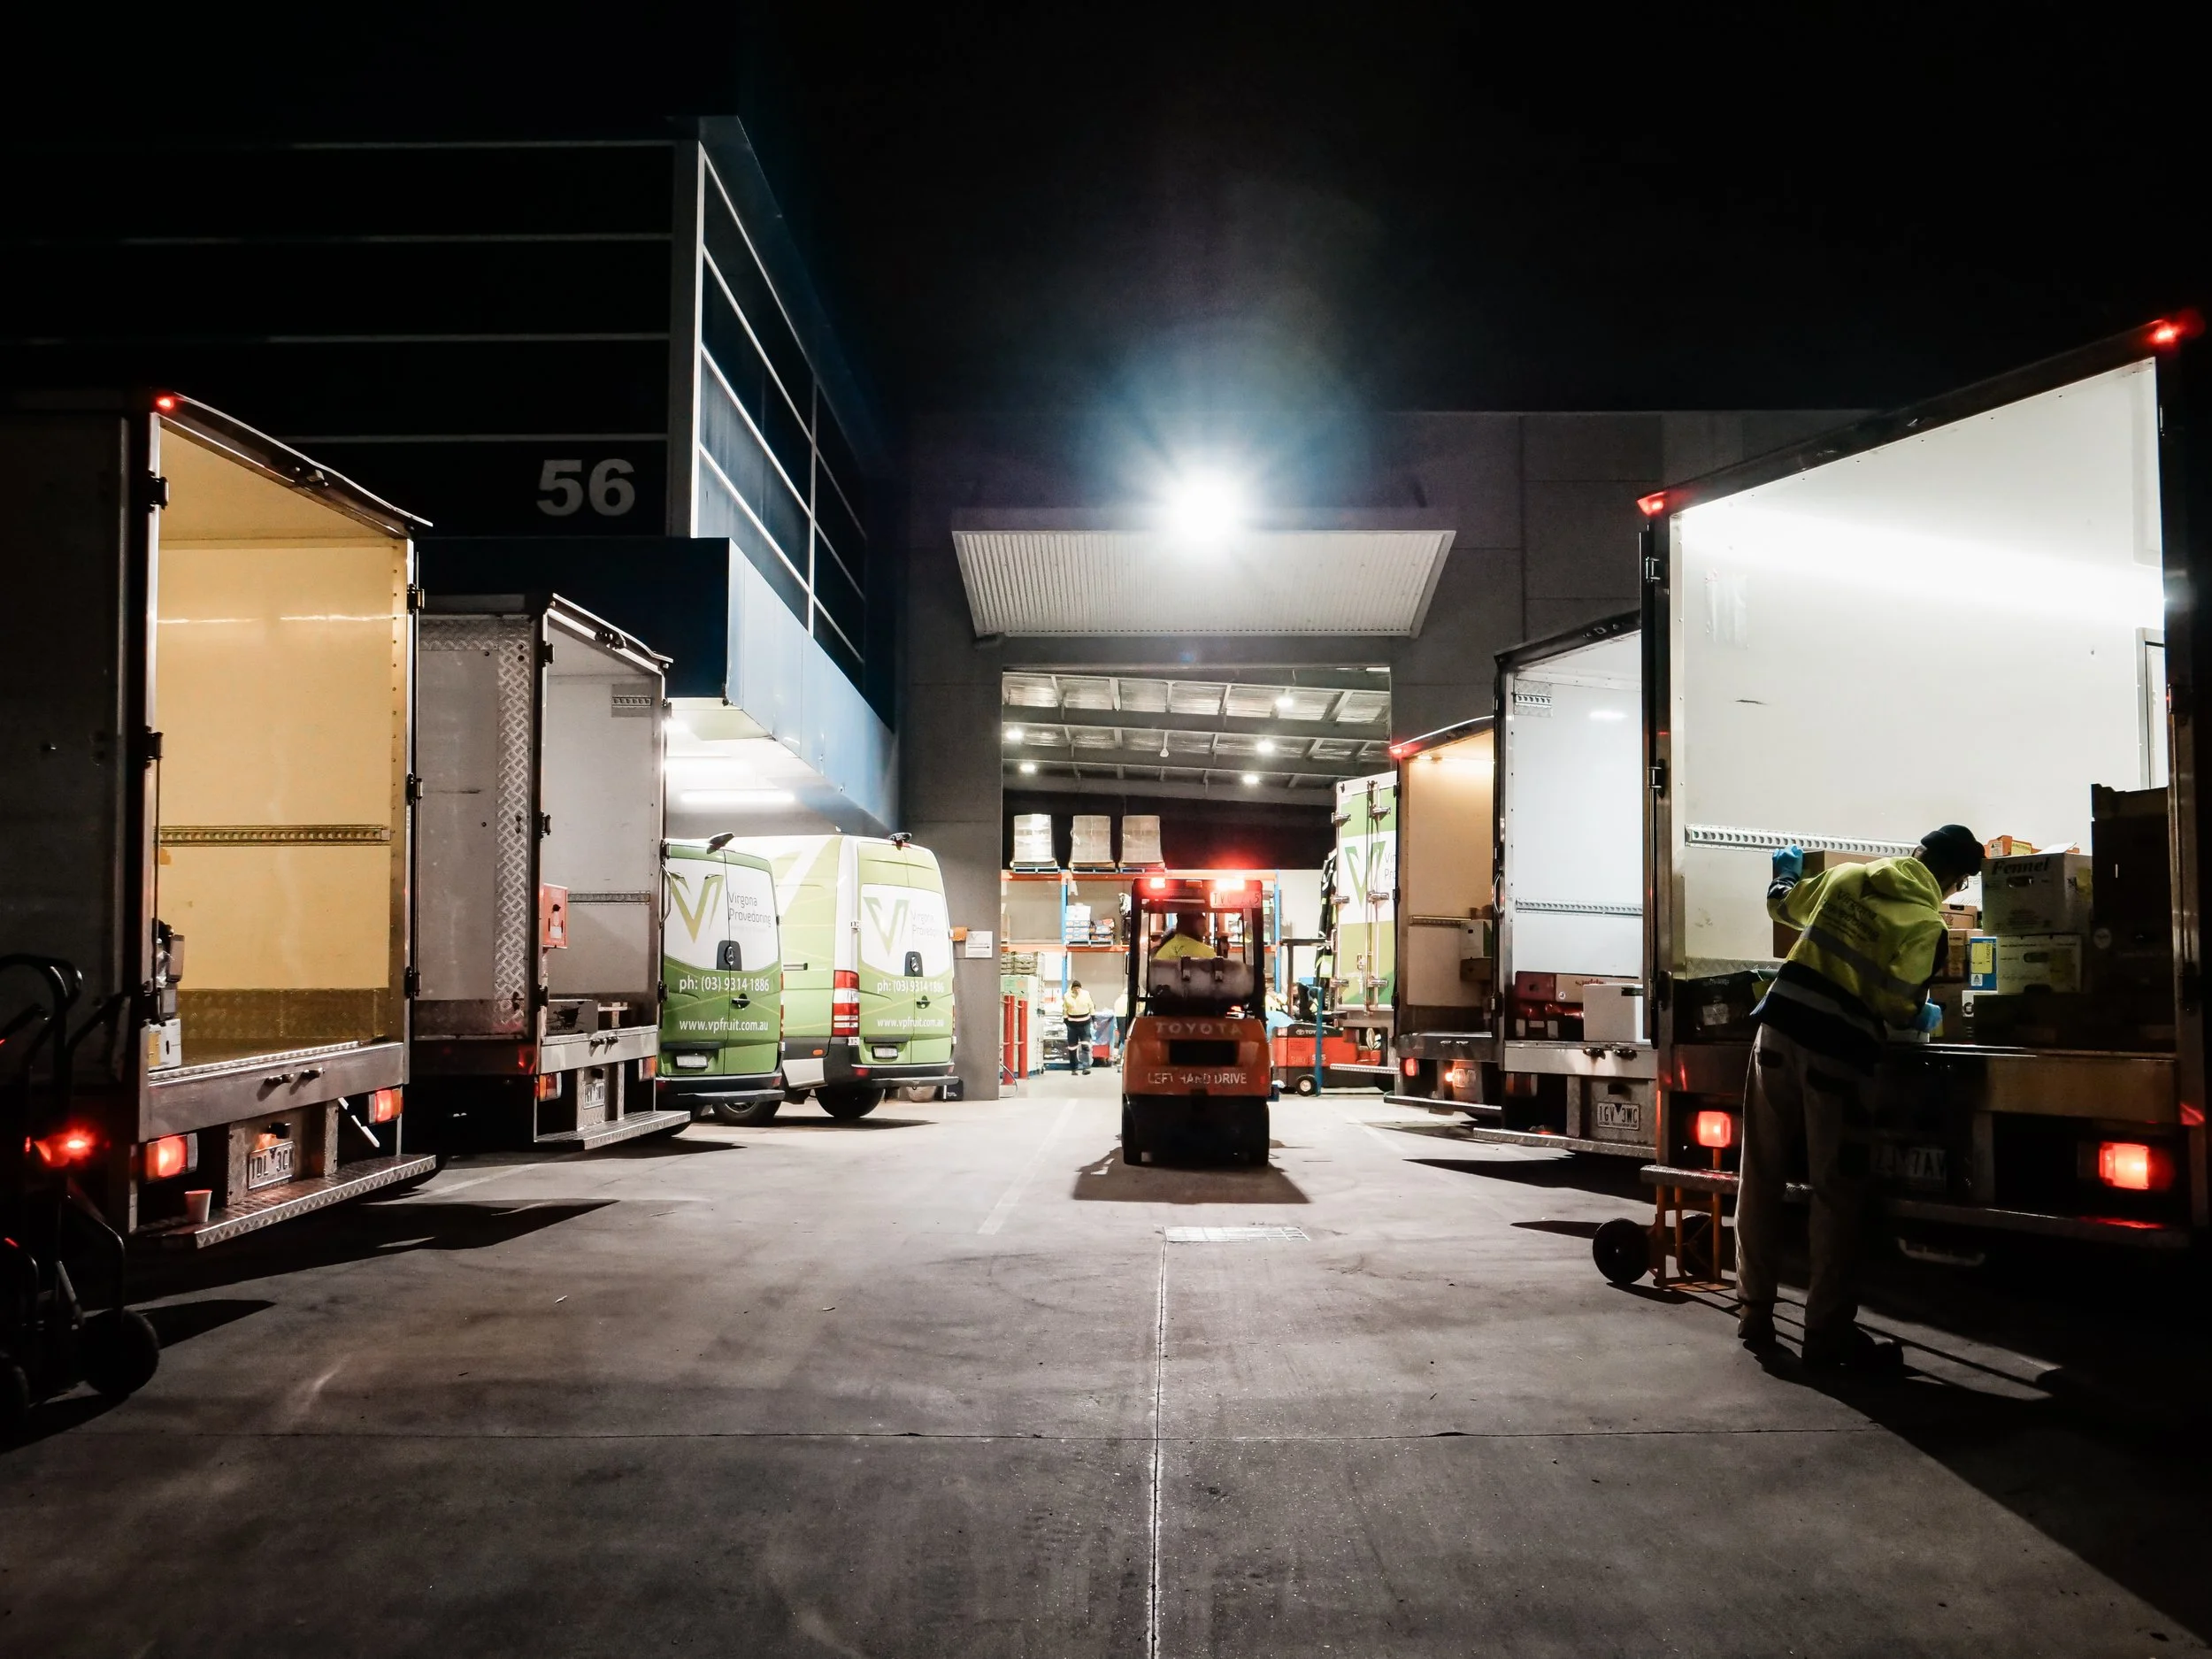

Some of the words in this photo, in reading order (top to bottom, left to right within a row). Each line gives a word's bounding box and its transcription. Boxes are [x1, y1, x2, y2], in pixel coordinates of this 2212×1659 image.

[536, 458, 635, 516] 56
[1992, 856, 2051, 875] Fennel
[728, 892, 757, 908] Virgona
[729, 908, 772, 928] Provedoring
[680, 975, 698, 993] ph:
[701, 976, 721, 992] (03)
[724, 977, 748, 991] 9314
[750, 978, 770, 992] 1886
[877, 979, 892, 994] ph:
[894, 980, 909, 993] (03)
[910, 980, 929, 992] 9314
[680, 1018, 769, 1033] www.vpfruit.com.au
[877, 1016, 944, 1029] www.vpfruit.com.au
[1156, 1022, 1242, 1035] TOYOTA
[1214, 1072, 1247, 1085] DRIVE
